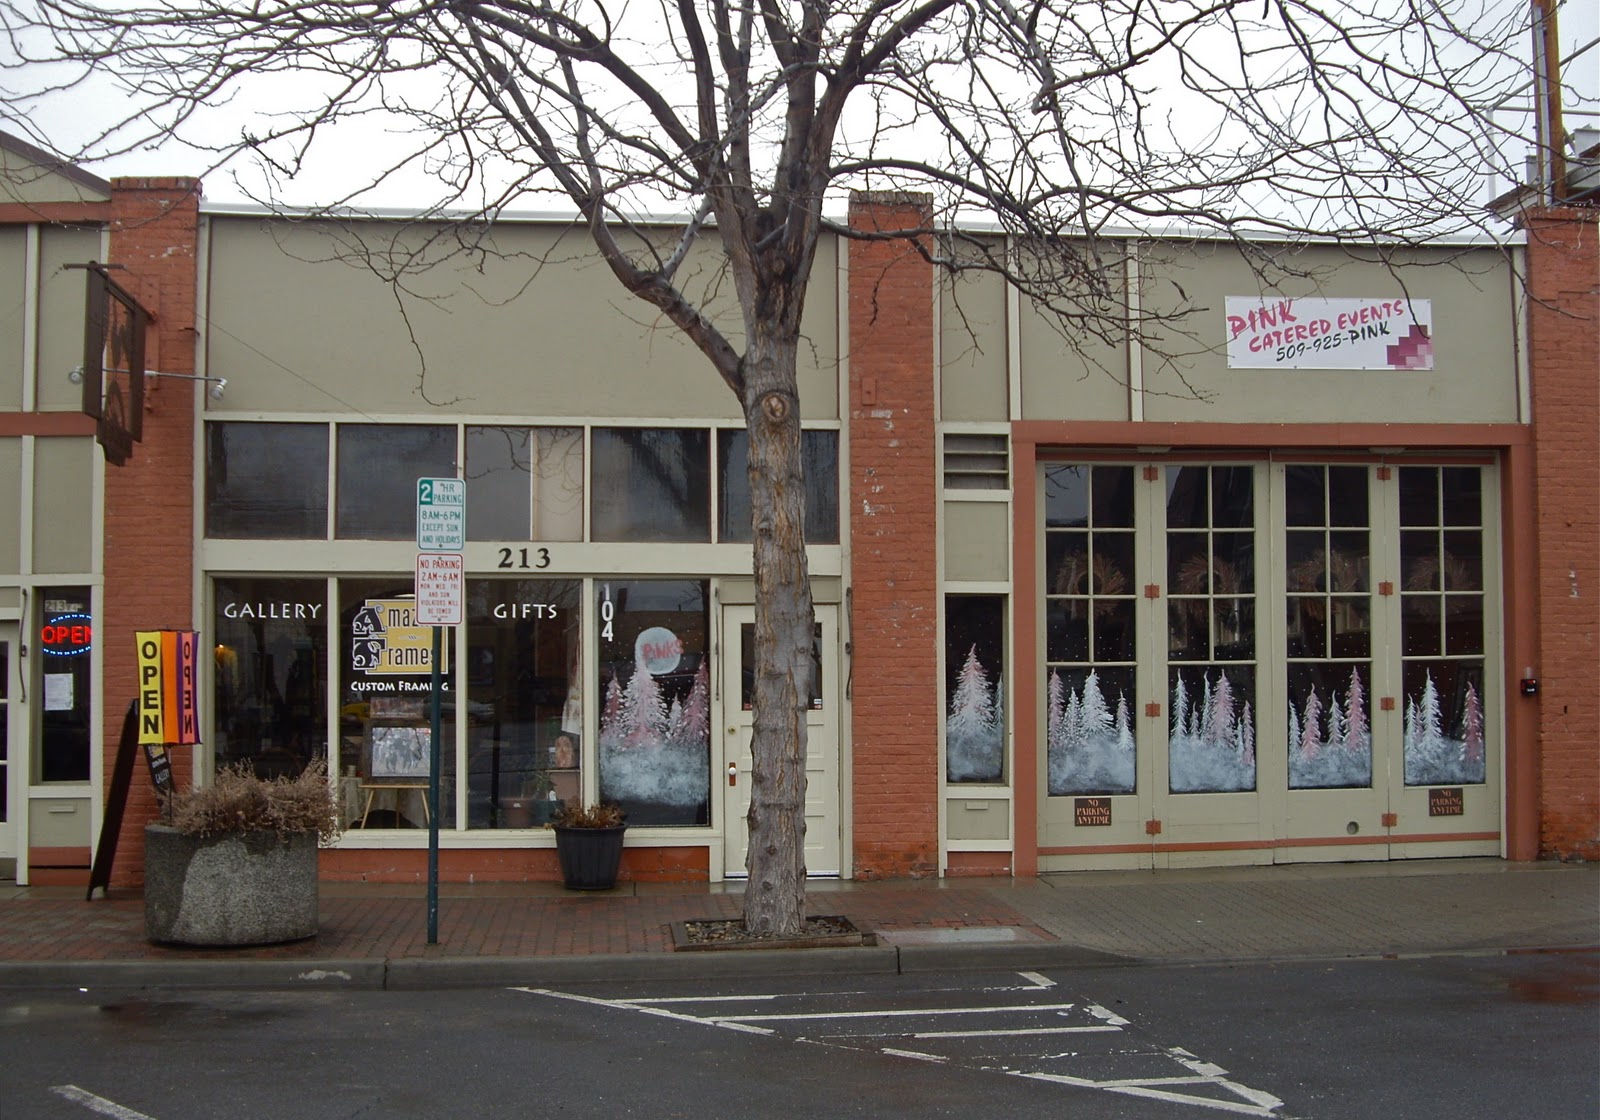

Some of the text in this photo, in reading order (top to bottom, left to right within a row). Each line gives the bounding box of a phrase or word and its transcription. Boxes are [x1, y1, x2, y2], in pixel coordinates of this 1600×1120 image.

[1227, 299, 1297, 339] PINK
[1249, 300, 1404, 352] CATERED EVENTS
[1276, 321, 1390, 362] 509-925-PINK
[421, 483, 431, 502] 2
[433, 494, 462, 503] PARKING
[422, 523, 444, 532] EXCEPT
[422, 535, 461, 544] AND HOLIDAYS
[498, 547, 550, 569] 213
[420, 560, 460, 569] NO PARKING
[224, 602, 322, 619] GALLERY
[493, 603, 558, 619] GIFTS
[141, 640, 159, 735] OPEN
[350, 680, 449, 692] CUSTOM FRAMIG
[1087, 799, 1099, 807] NO
[1431, 797, 1462, 806] PARKING
[1076, 807, 1110, 816] PARKING
[1432, 806, 1461, 815] ANYTIME
[1077, 816, 1110, 825] ANYTIME
